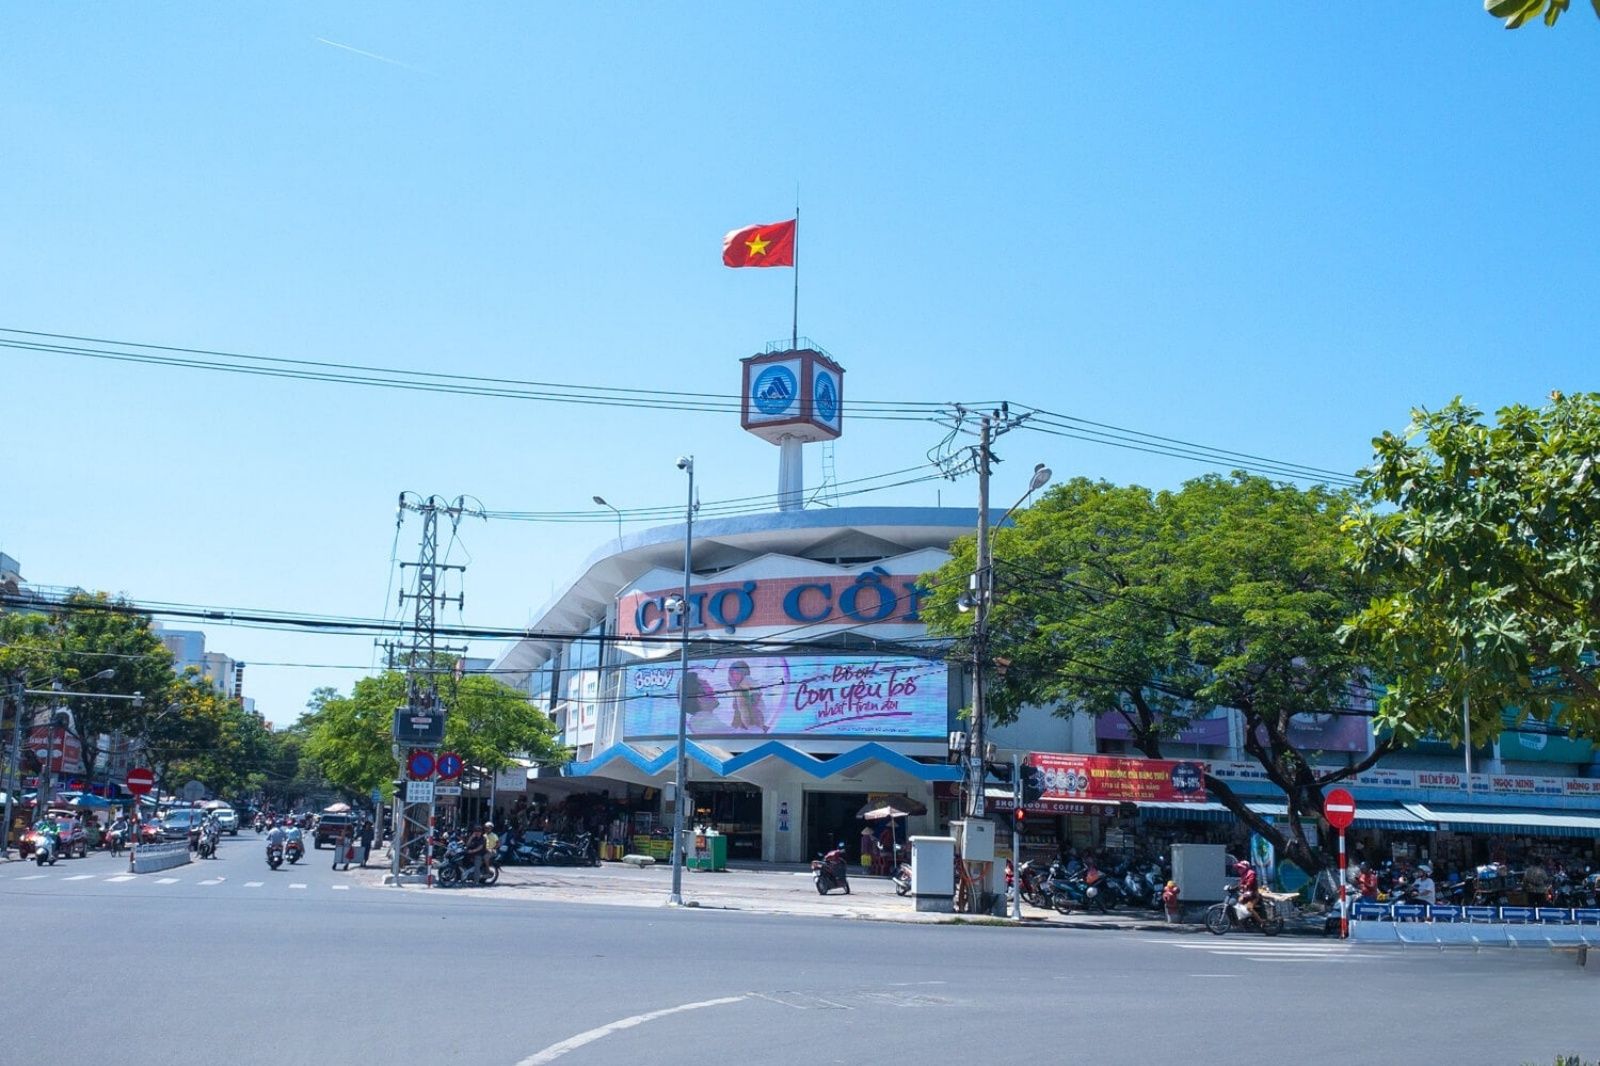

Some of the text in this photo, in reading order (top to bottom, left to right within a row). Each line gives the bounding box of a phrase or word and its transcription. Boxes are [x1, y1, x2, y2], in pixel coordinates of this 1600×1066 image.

[634, 580, 757, 635] CHỢ
[634, 668, 674, 690] Bobby
[795, 682, 834, 711] Con
[840, 680, 882, 711] yêu
[995, 799, 1049, 809] SHOOOM
[1053, 803, 1085, 812] COFFEE
